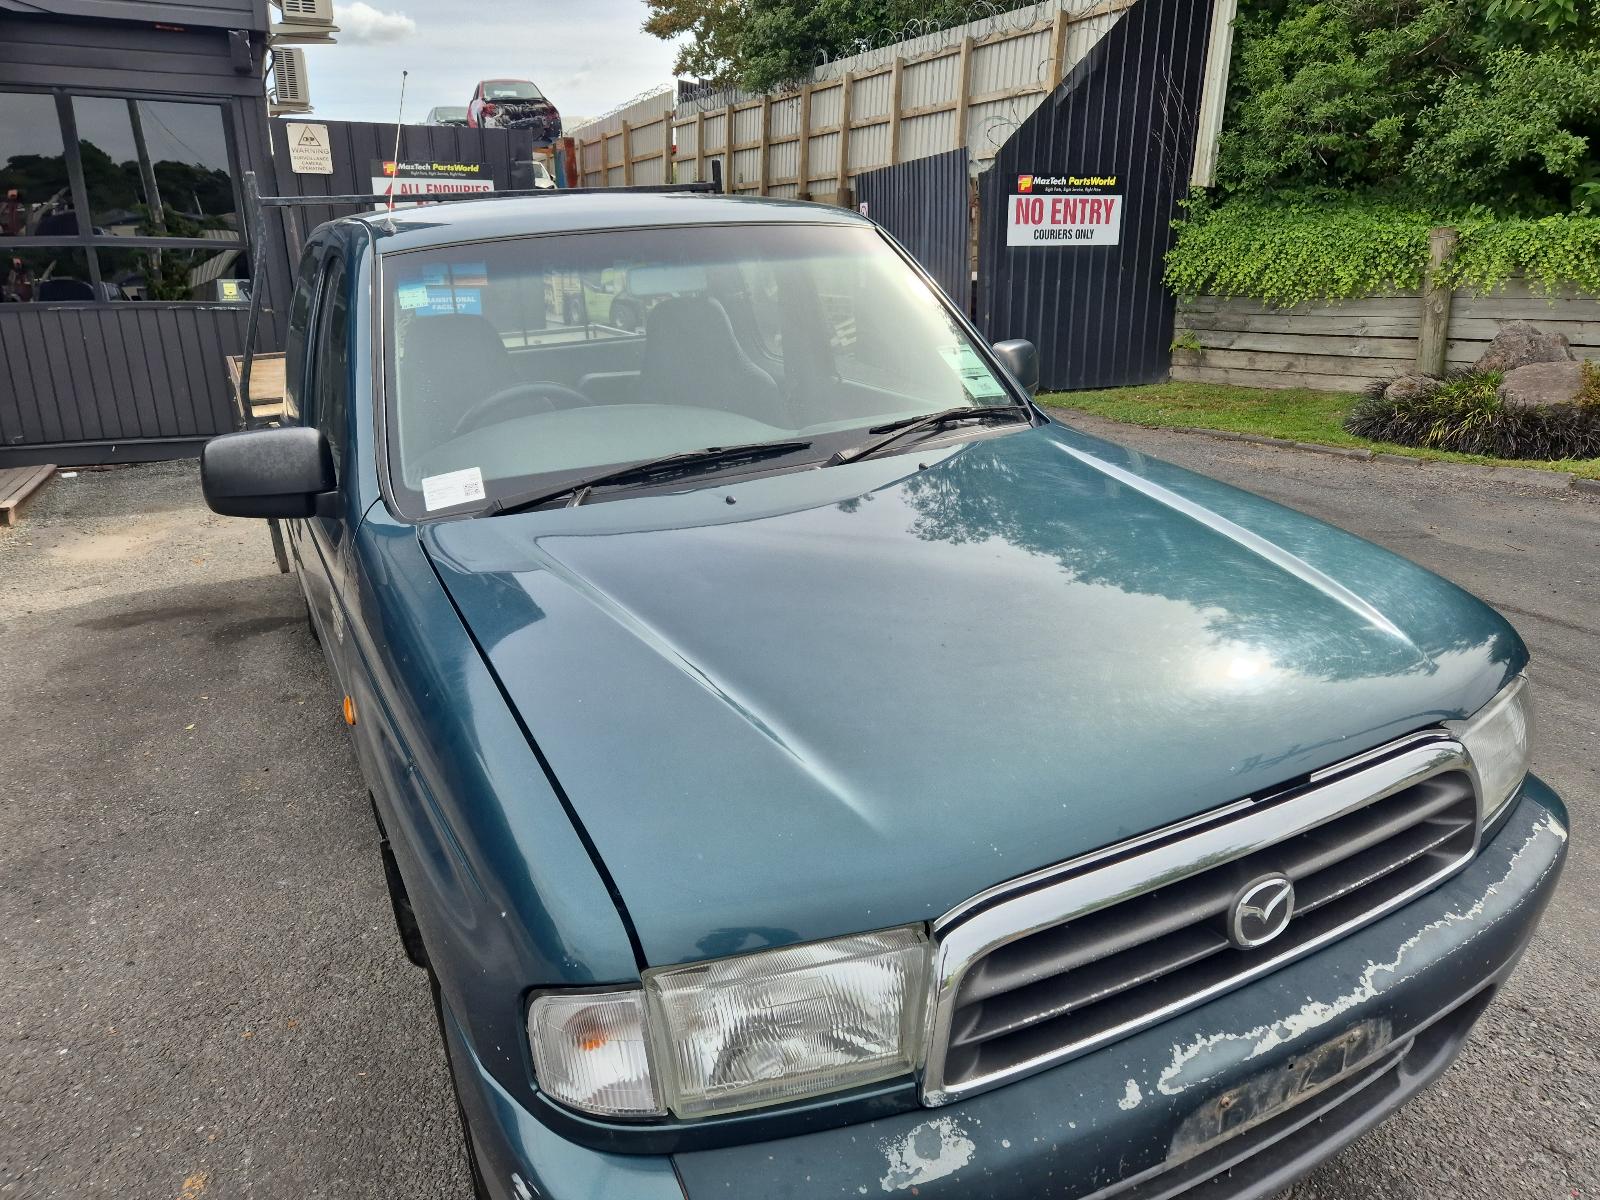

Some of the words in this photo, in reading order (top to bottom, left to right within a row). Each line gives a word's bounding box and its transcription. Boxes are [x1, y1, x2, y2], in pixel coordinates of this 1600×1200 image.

[432, 163, 479, 172] PartsWorld
[1033, 176, 1067, 185] MazTech
[1068, 176, 1116, 186] PartsWorld
[400, 183, 419, 194] ALL
[1015, 198, 1044, 225] NO
[1050, 198, 1116, 225] ENTRY
[1033, 229, 1073, 240] COURIERS
[1075, 229, 1094, 240] ONLY
